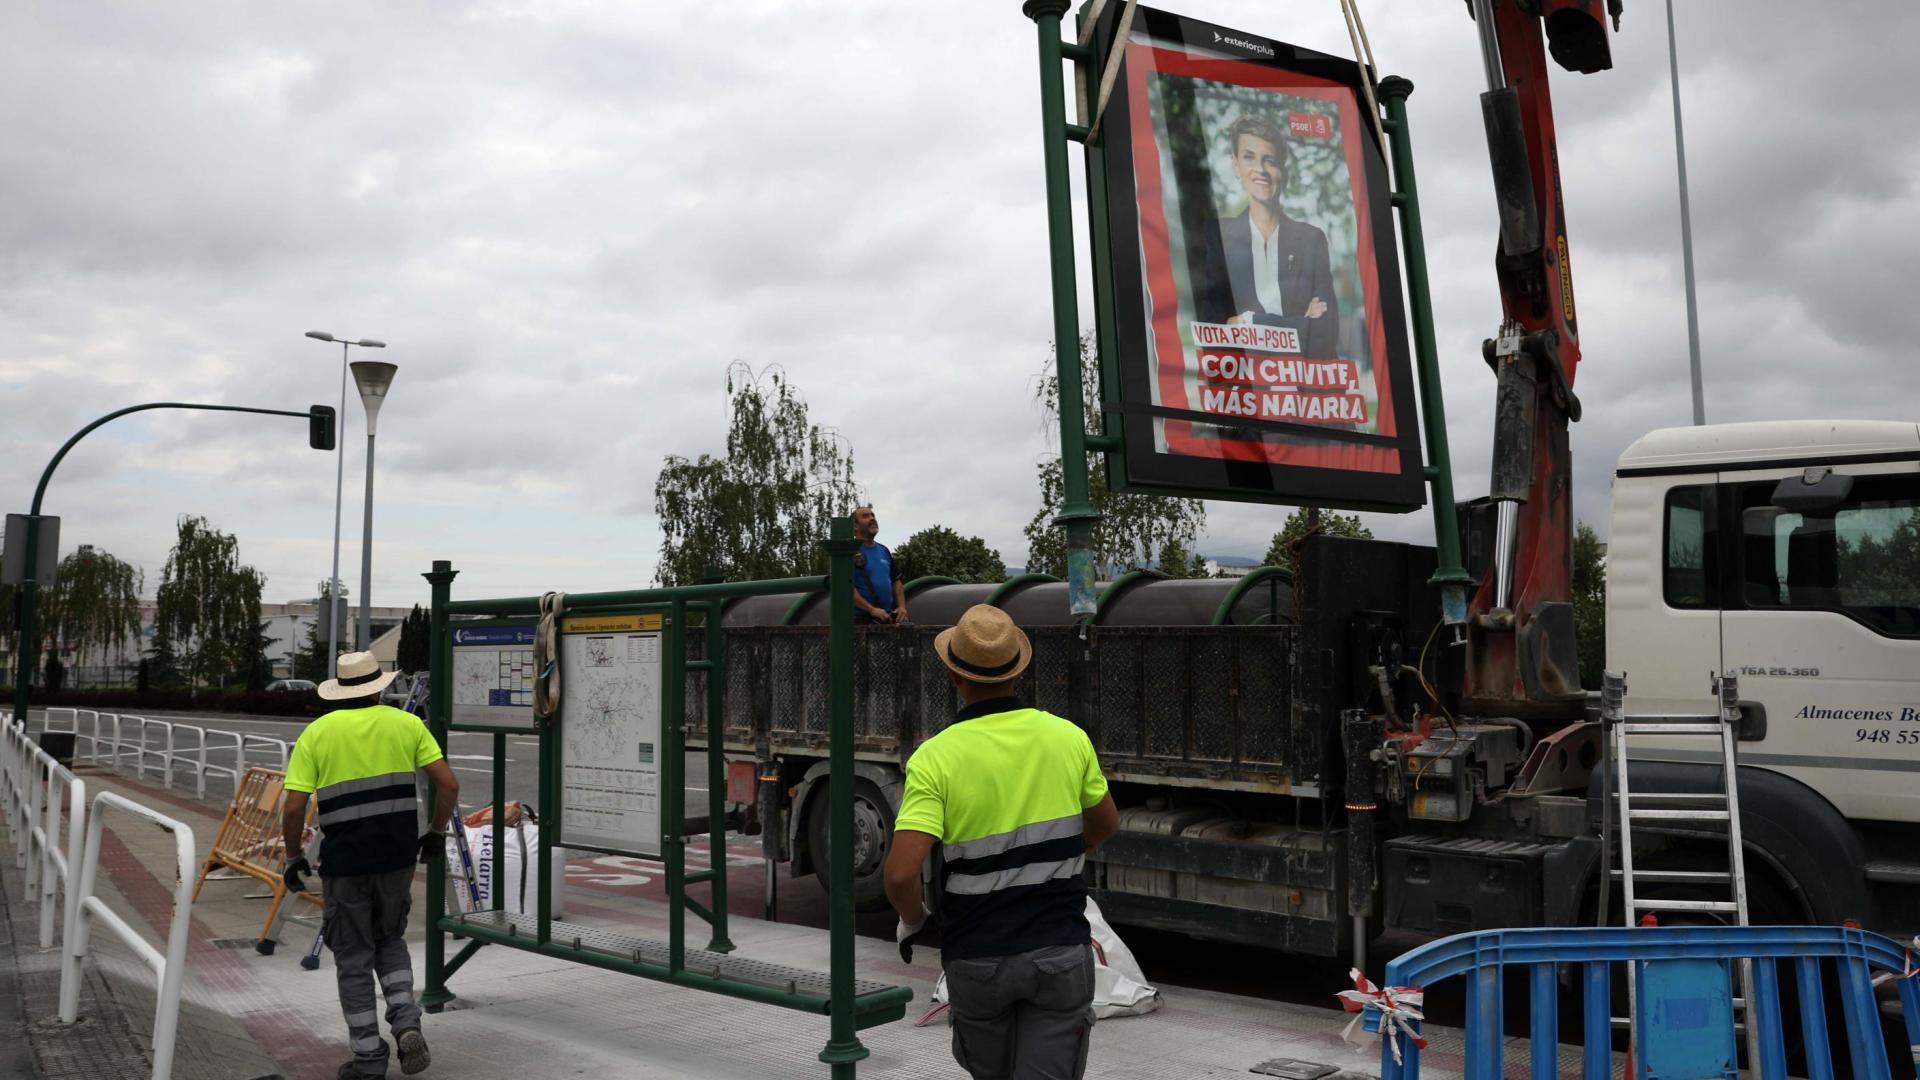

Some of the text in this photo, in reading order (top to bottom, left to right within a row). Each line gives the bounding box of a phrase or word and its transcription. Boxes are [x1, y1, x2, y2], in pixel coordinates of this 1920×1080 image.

[1224, 36, 1275, 56] exteriorplus
[1291, 122, 1309, 132] PSOE
[1558, 240, 1572, 315] PALFINGER
[1194, 325, 1297, 349] VOTA PSN-PSOE
[1202, 354, 1255, 380] CON
[1204, 386, 1364, 420] MÁS NAVARRA
[1769, 667, 1820, 677] 26.360
[1795, 705, 1894, 721] Almacenes
[1856, 729, 1920, 744] 948 55
